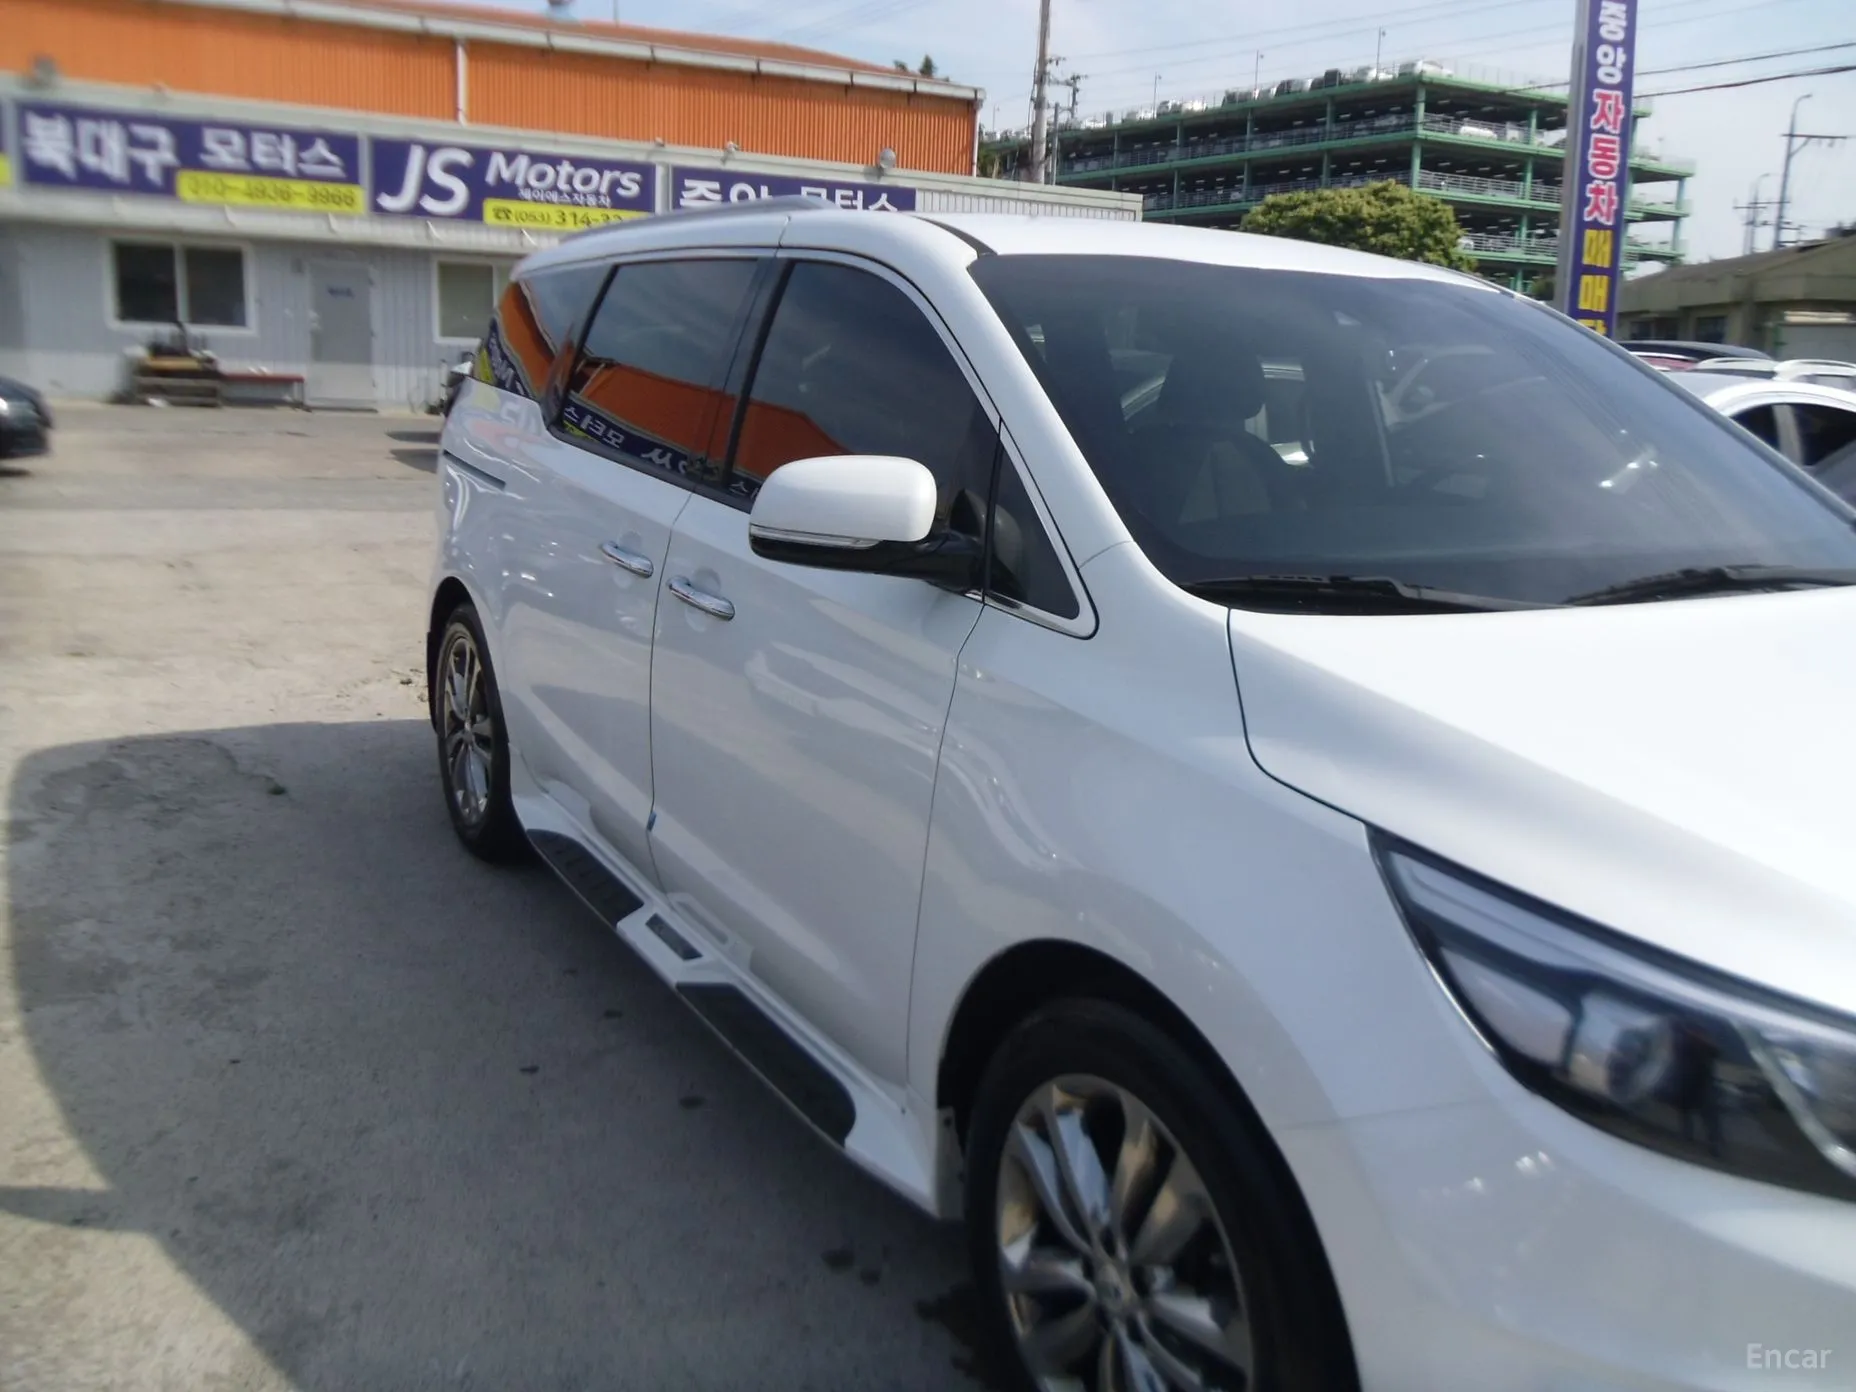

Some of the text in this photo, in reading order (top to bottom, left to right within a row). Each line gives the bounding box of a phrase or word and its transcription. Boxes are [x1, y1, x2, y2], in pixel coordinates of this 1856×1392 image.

[1596, 1, 1626, 84] 중앙
[24, 111, 347, 187] 북대구 모터스
[376, 144, 643, 215] JS Motors
[1583, 88, 1625, 226] 자동차
